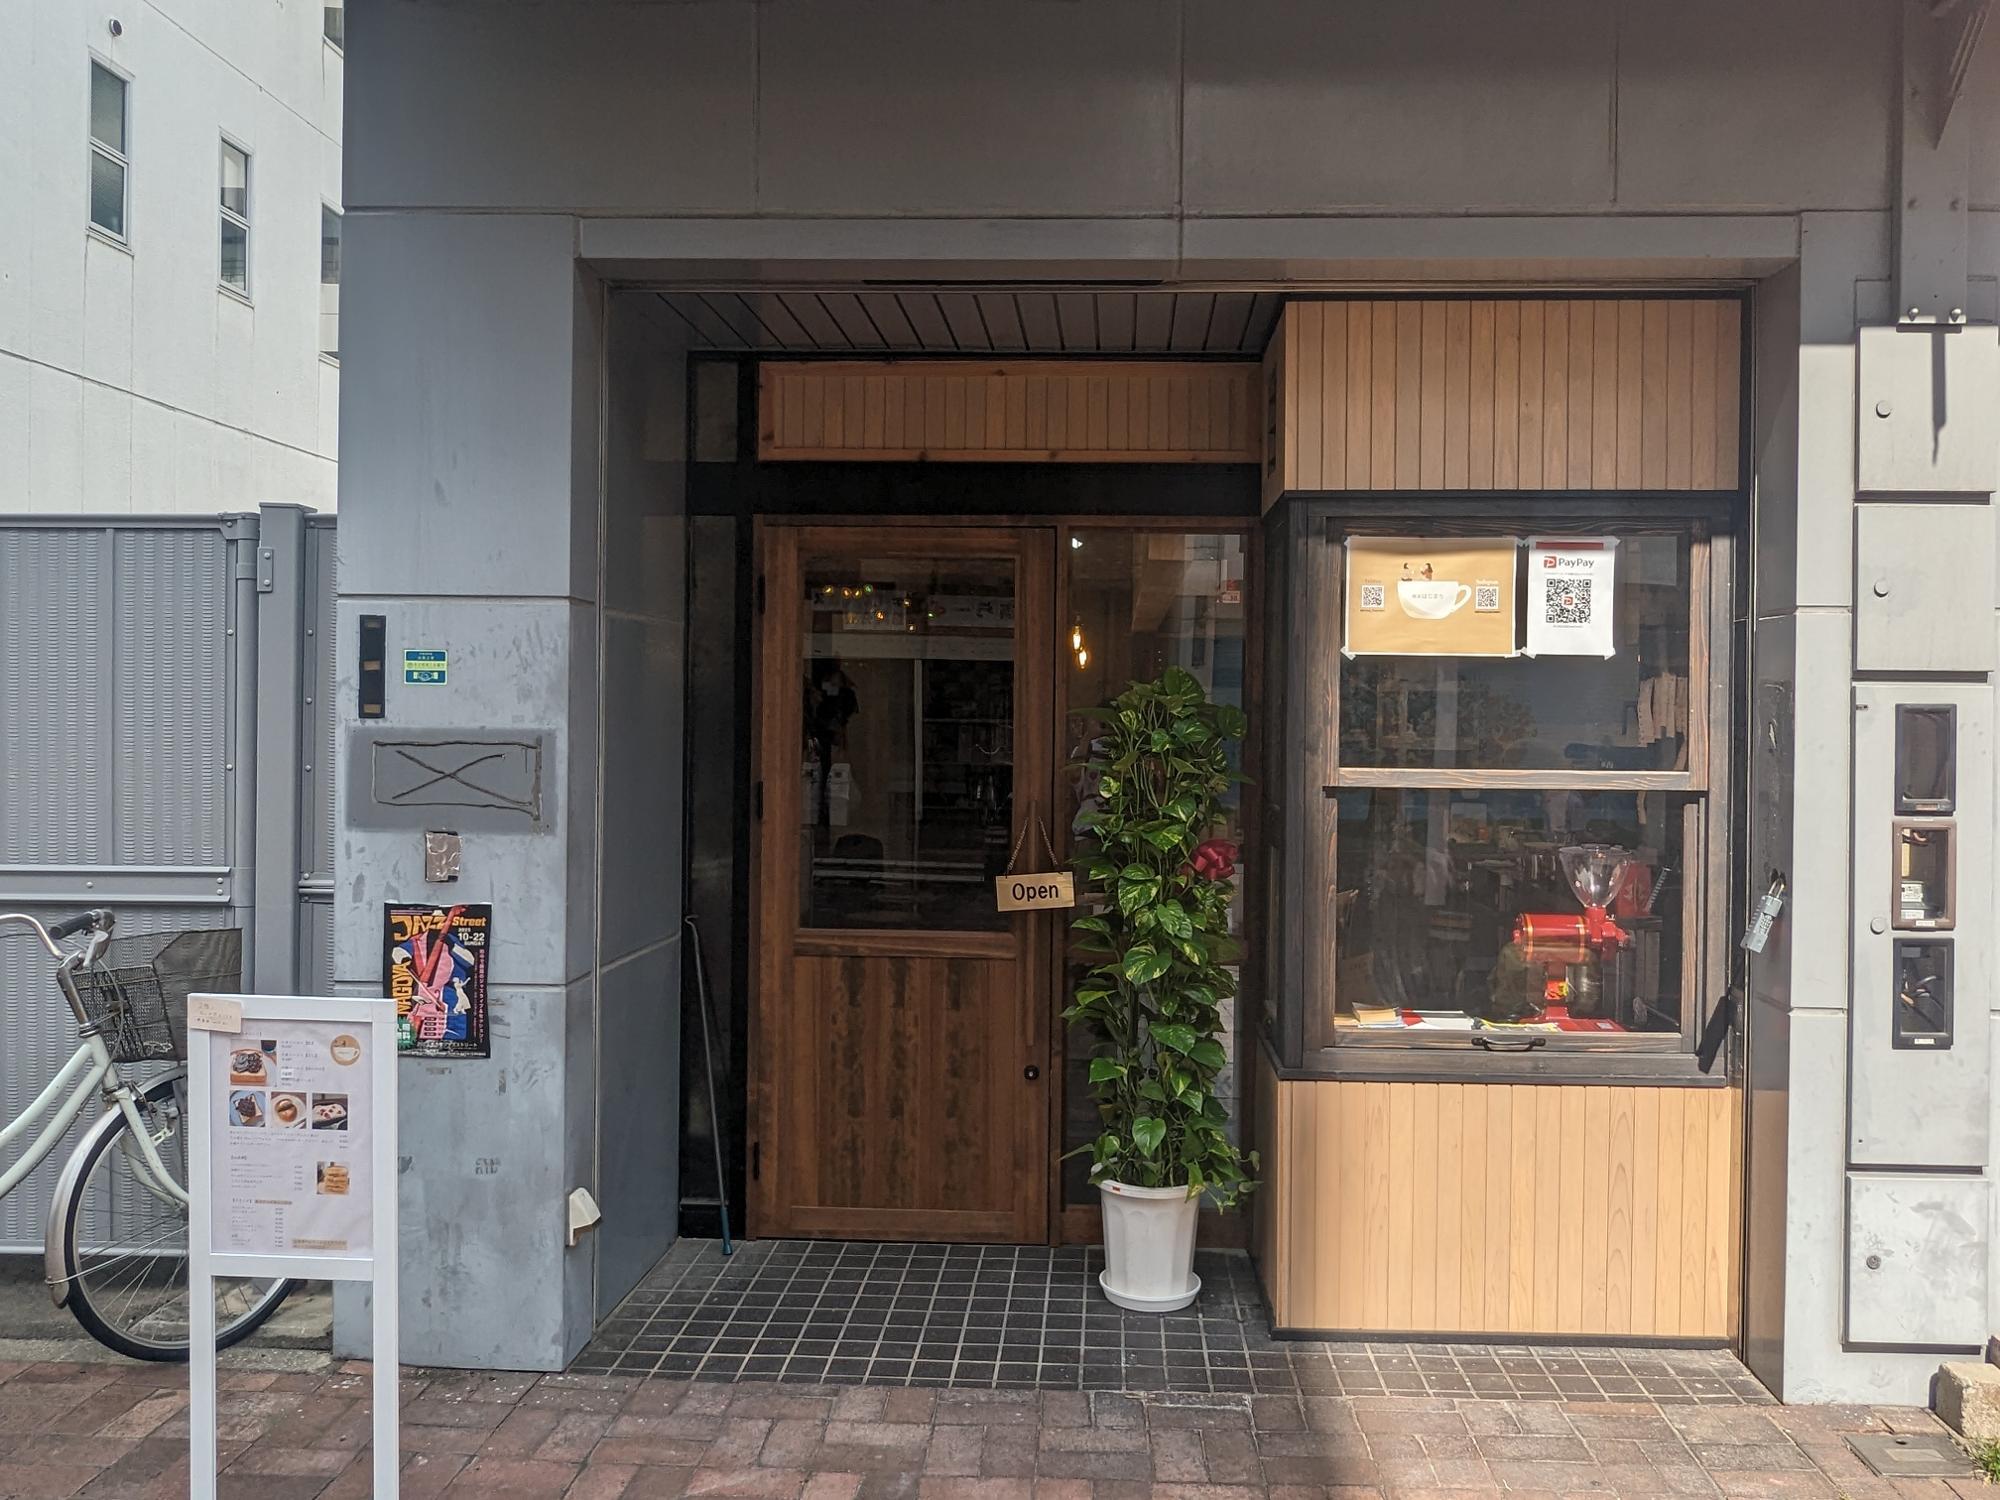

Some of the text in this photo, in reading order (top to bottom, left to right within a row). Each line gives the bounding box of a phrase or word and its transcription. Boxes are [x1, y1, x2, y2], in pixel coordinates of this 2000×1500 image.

[1558, 557, 1595, 569] PayPay
[1012, 883, 1059, 902] Open
[390, 915, 487, 941] JAZZ Street
[392, 961, 413, 1015] NAGOYA
